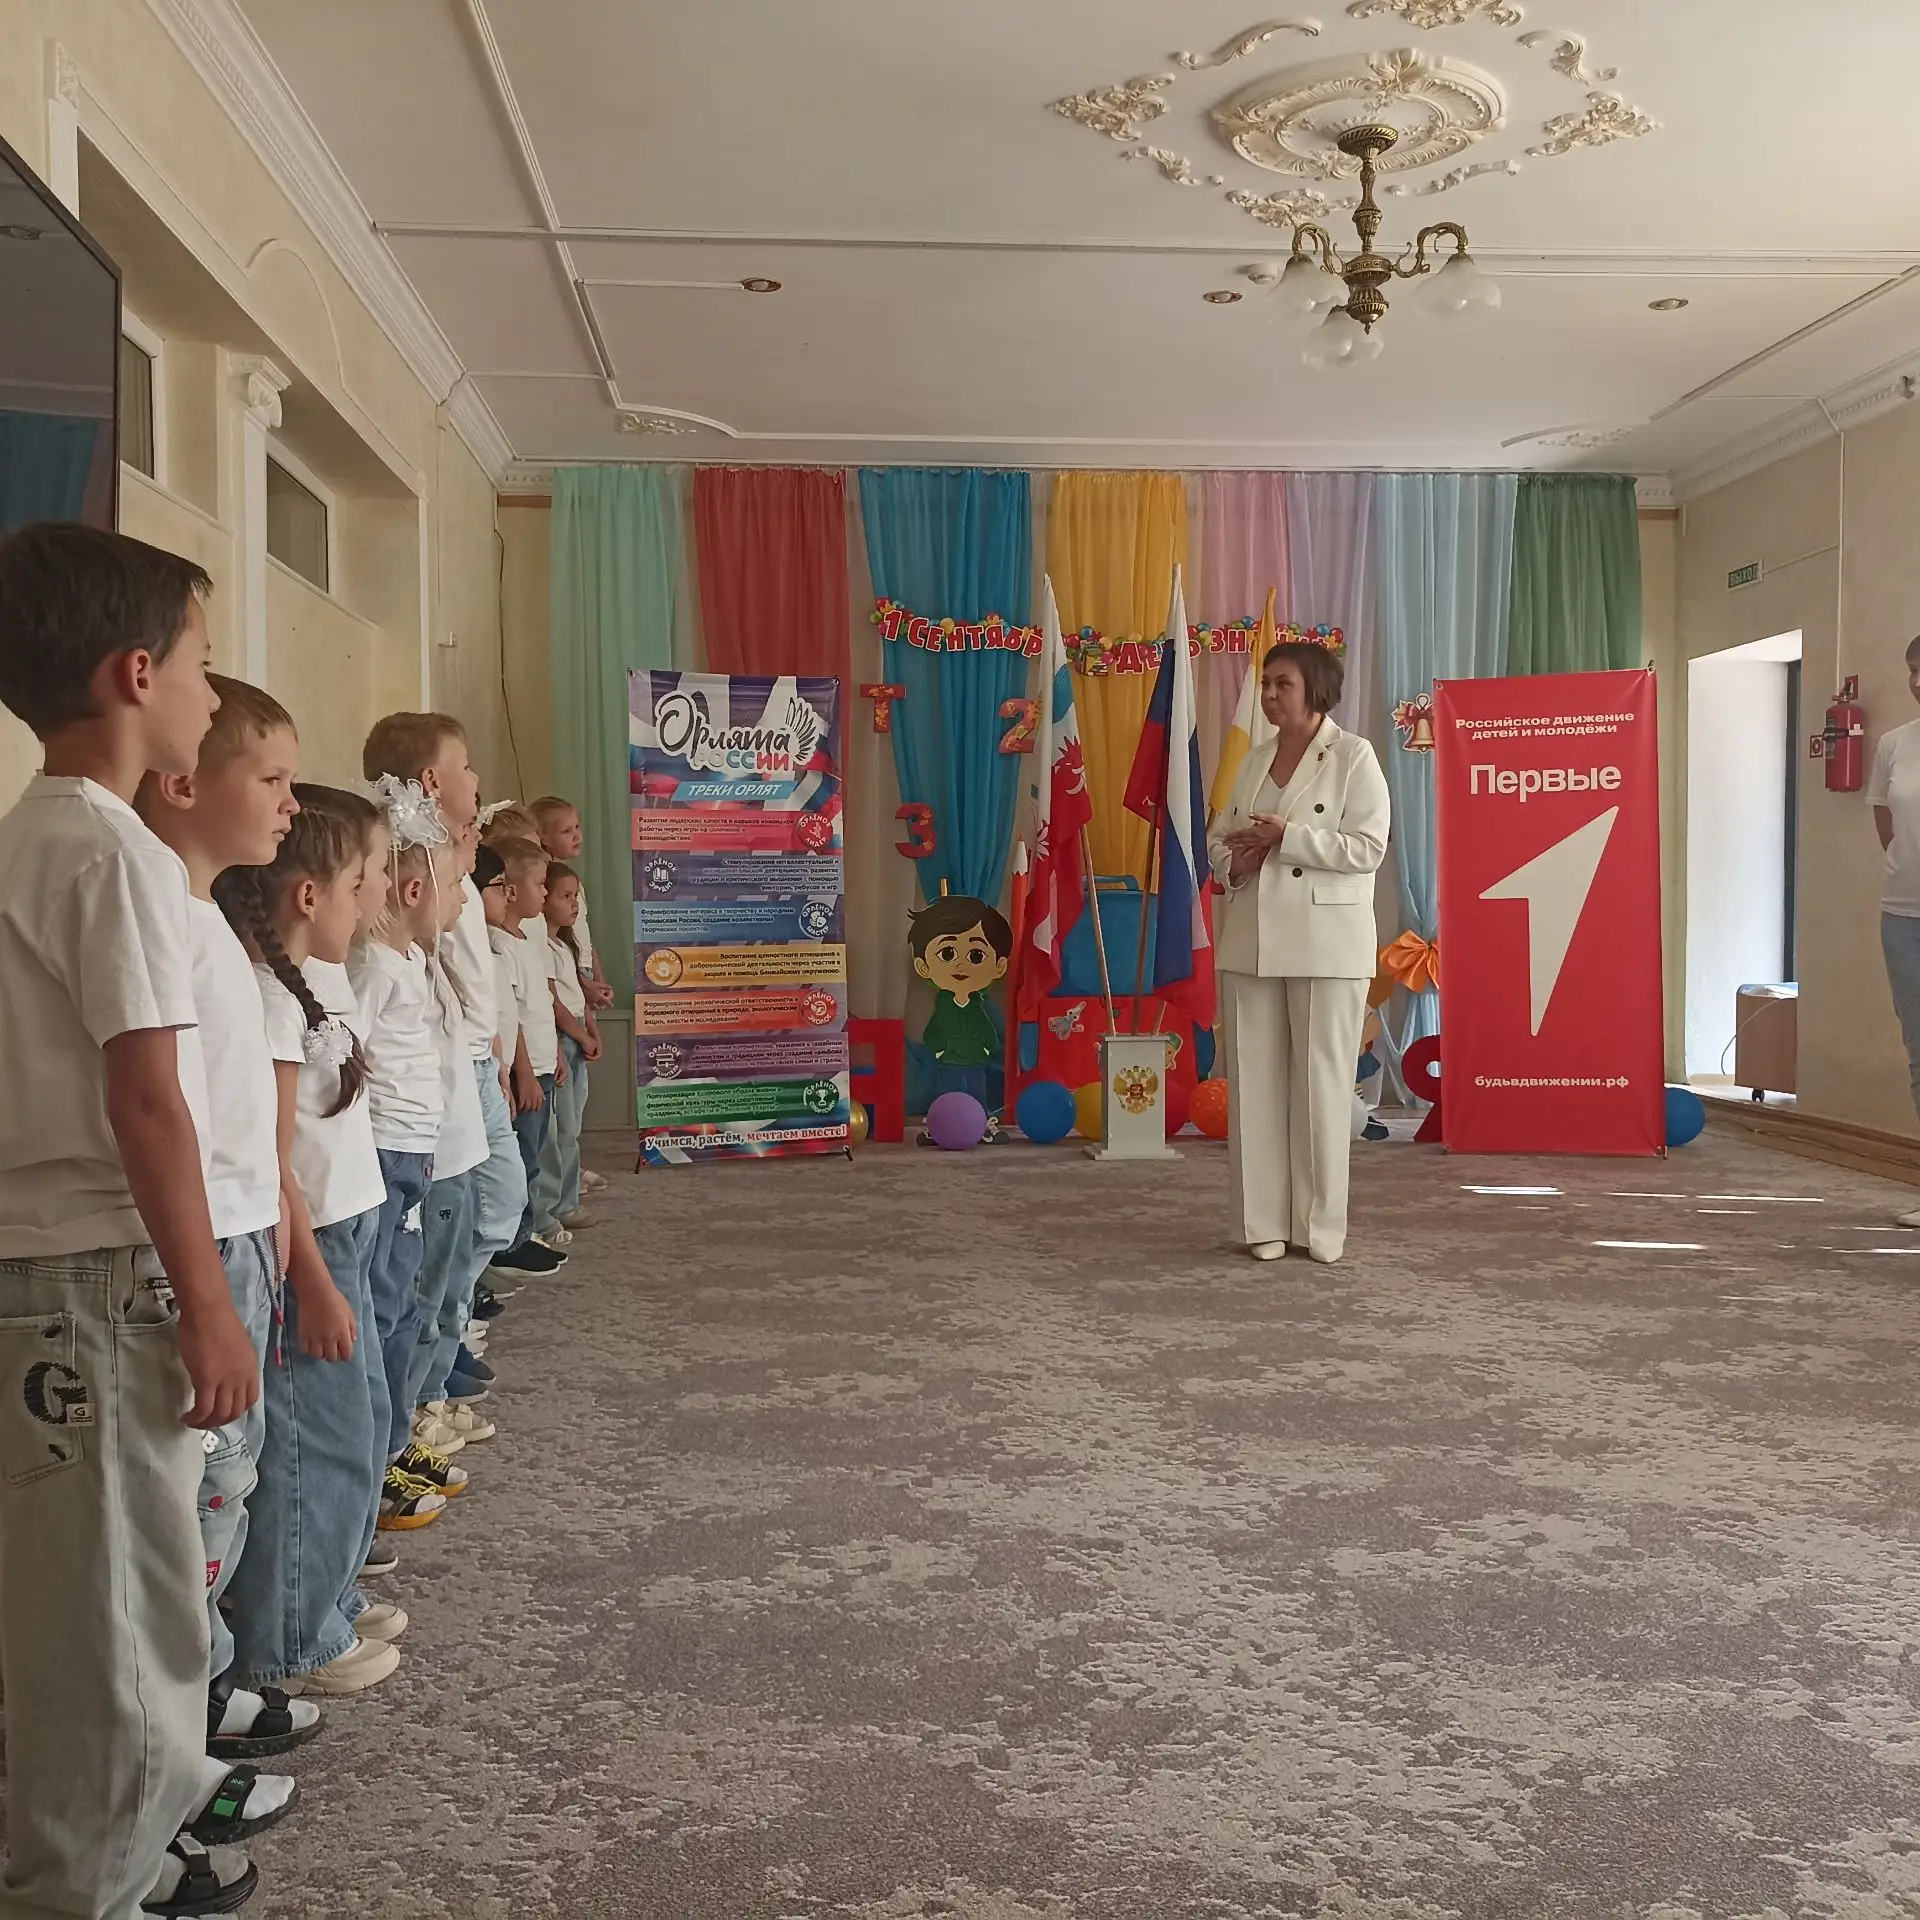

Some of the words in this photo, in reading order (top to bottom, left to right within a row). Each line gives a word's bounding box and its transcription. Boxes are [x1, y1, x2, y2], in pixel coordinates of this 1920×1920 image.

[883, 610, 903, 641] 1
[907, 616, 1044, 658] СЕНТЯБР
[999, 698, 1037, 753] 2
[1455, 716, 1550, 729] Российское
[1553, 712, 1635, 726] движение
[1472, 727, 1518, 740] детей
[1521, 728, 1532, 737] и
[1534, 723, 1618, 736] молодёжи
[688, 785, 733, 796] ТРЕКИ
[735, 784, 782, 796] ОРЛЯТ
[1470, 764, 1622, 803] Первые
[895, 802, 937, 859] 3
[807, 925, 829, 937] МАСТЕР
[1474, 1075, 1629, 1089] будьвдвижении.рф
[646, 1134, 697, 1150] Учимся,
[699, 1132, 745, 1148] растём,
[747, 1130, 800, 1142] мечтаем
[801, 1125, 847, 1139] вместе!
